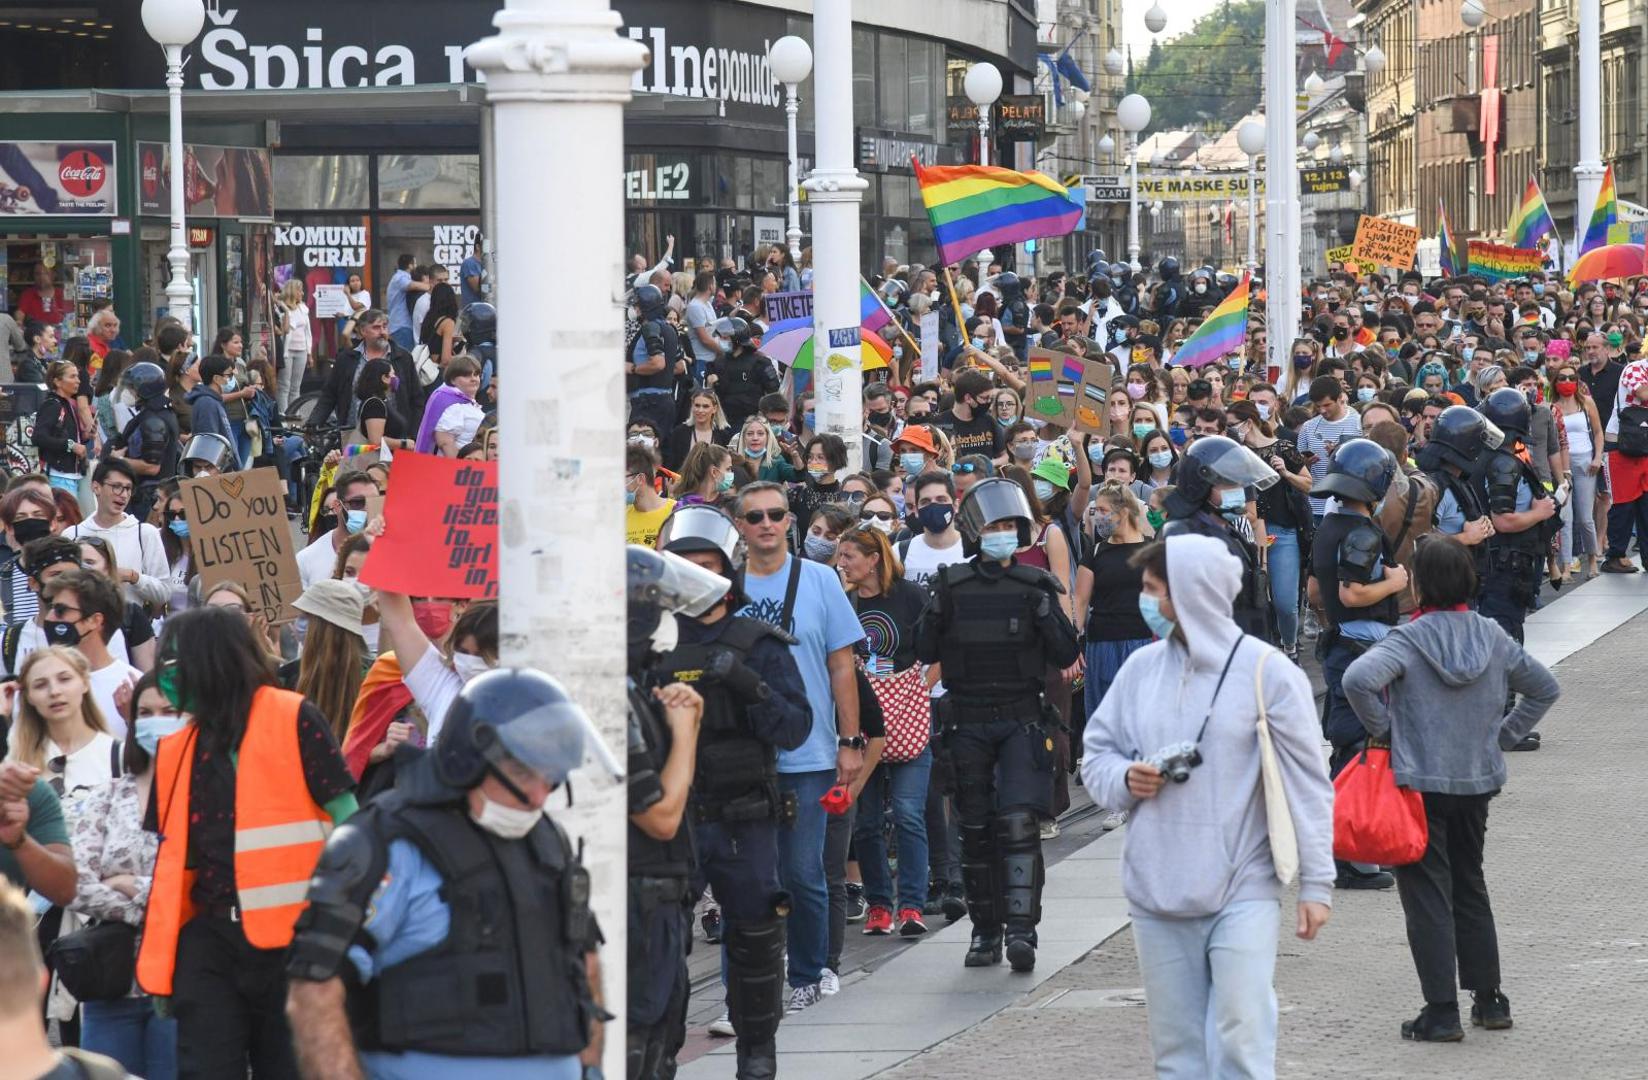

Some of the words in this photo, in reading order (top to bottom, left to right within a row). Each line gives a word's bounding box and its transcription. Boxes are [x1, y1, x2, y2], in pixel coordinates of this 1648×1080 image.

[200, 9, 415, 90] Špica
[623, 162, 690, 199] ELE2
[1167, 180, 1224, 193] MASKE
[1228, 179, 1249, 190] SU
[274, 226, 367, 246] KOMUNI
[303, 247, 367, 267] CIRAJ
[454, 466, 485, 486] do
[241, 495, 278, 518] YOU
[442, 504, 498, 525] liste
[199, 526, 281, 567] LISTEN
[444, 526, 470, 546] to
[448, 543, 492, 569] girl
[253, 561, 278, 580] TO
[465, 564, 488, 585] in
[259, 581, 282, 606] IN
